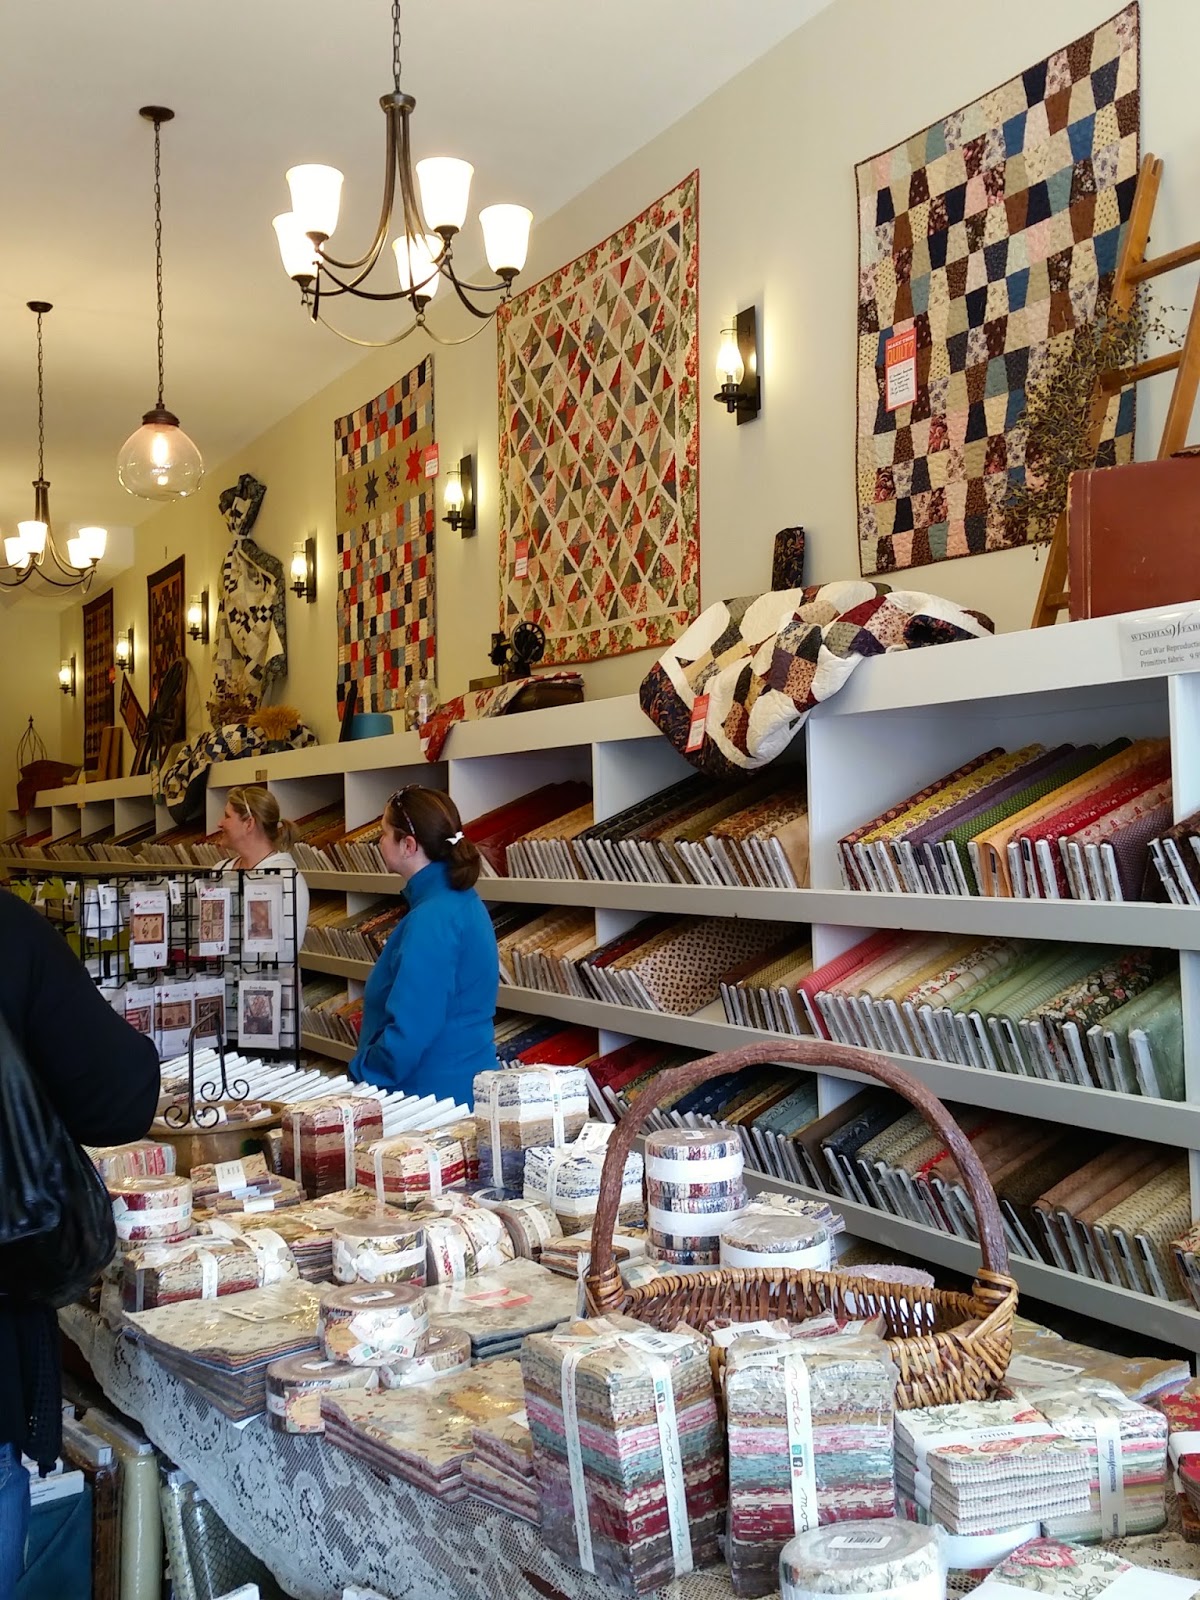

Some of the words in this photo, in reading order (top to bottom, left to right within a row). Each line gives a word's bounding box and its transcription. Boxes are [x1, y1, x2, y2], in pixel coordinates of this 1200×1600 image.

[887, 340, 914, 365] QUILT?
[1130, 629, 1173, 641] WINDHAM
[1182, 623, 1200, 633] FAB
[790, 1367, 803, 1436] moda
[665, 1421, 678, 1492] moda
[673, 1496, 686, 1561] moda
